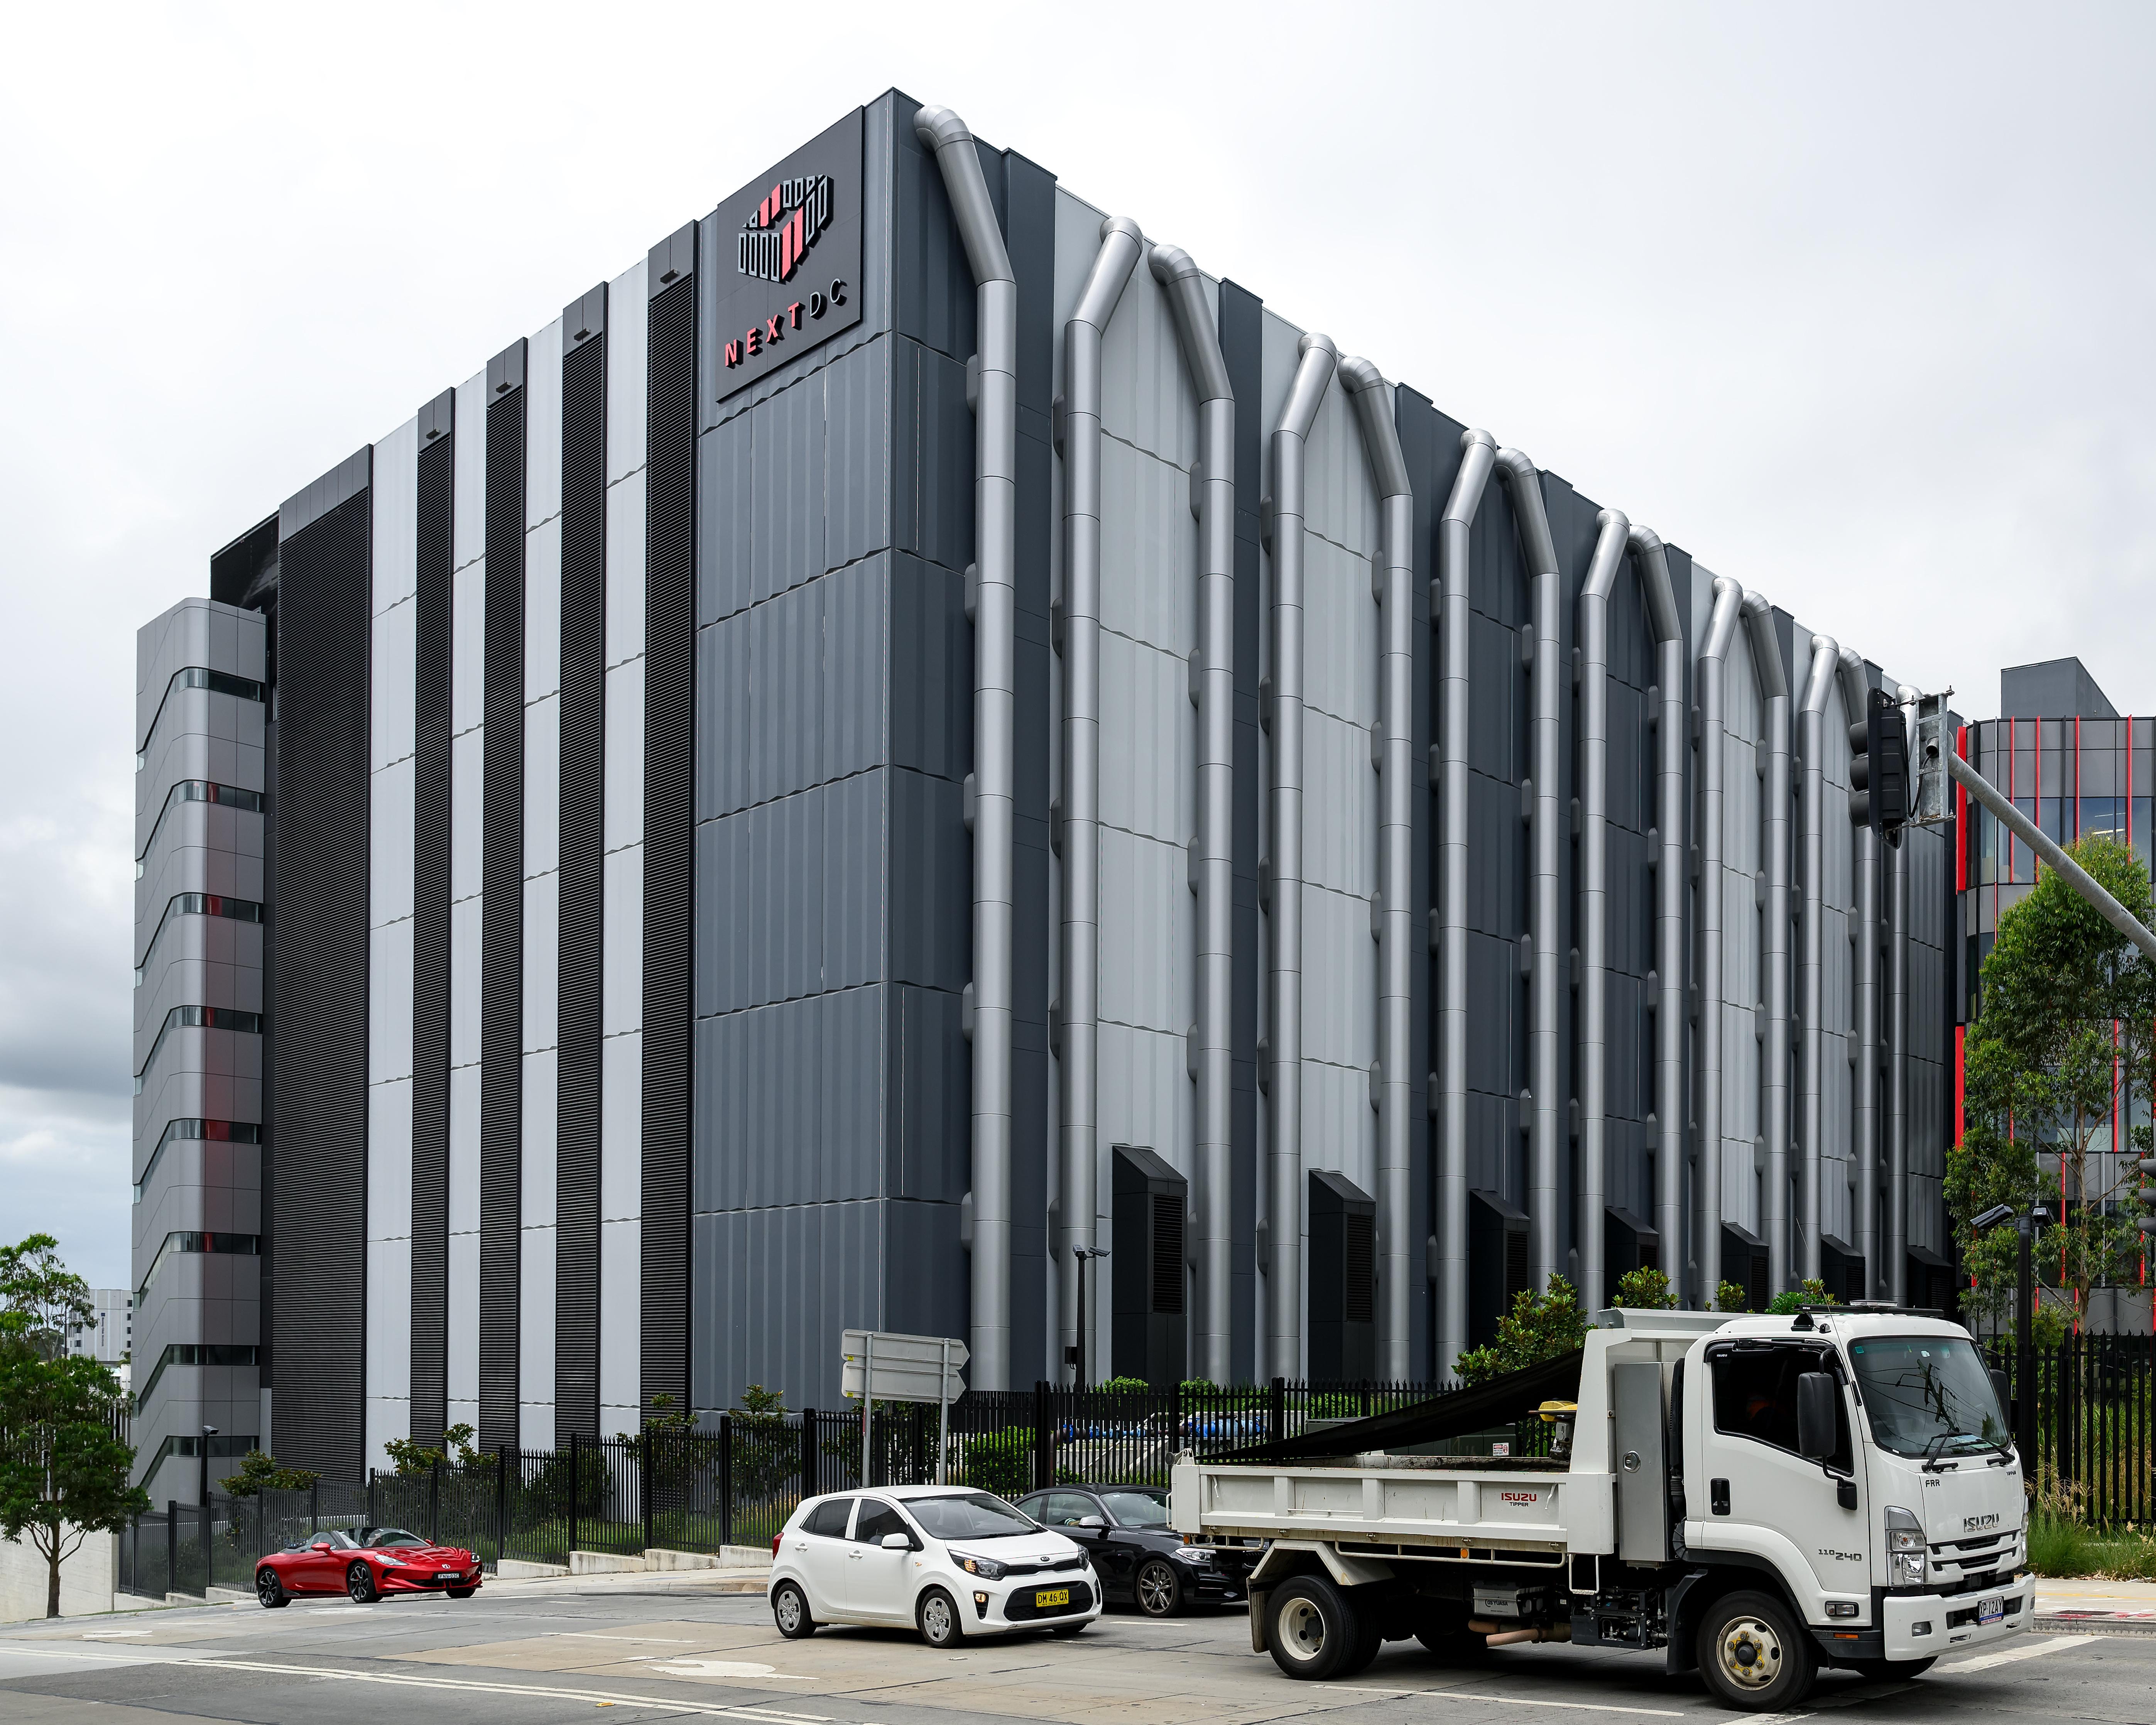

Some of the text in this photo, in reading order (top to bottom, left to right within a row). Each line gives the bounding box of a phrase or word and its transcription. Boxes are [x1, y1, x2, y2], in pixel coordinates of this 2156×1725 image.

[725, 278, 844, 367] NEXTDC
[1925, 1479, 1940, 1487] FRR
[1501, 1492, 1537, 1502] ISUZU
[1963, 1512, 1999, 1532] ISUZU
